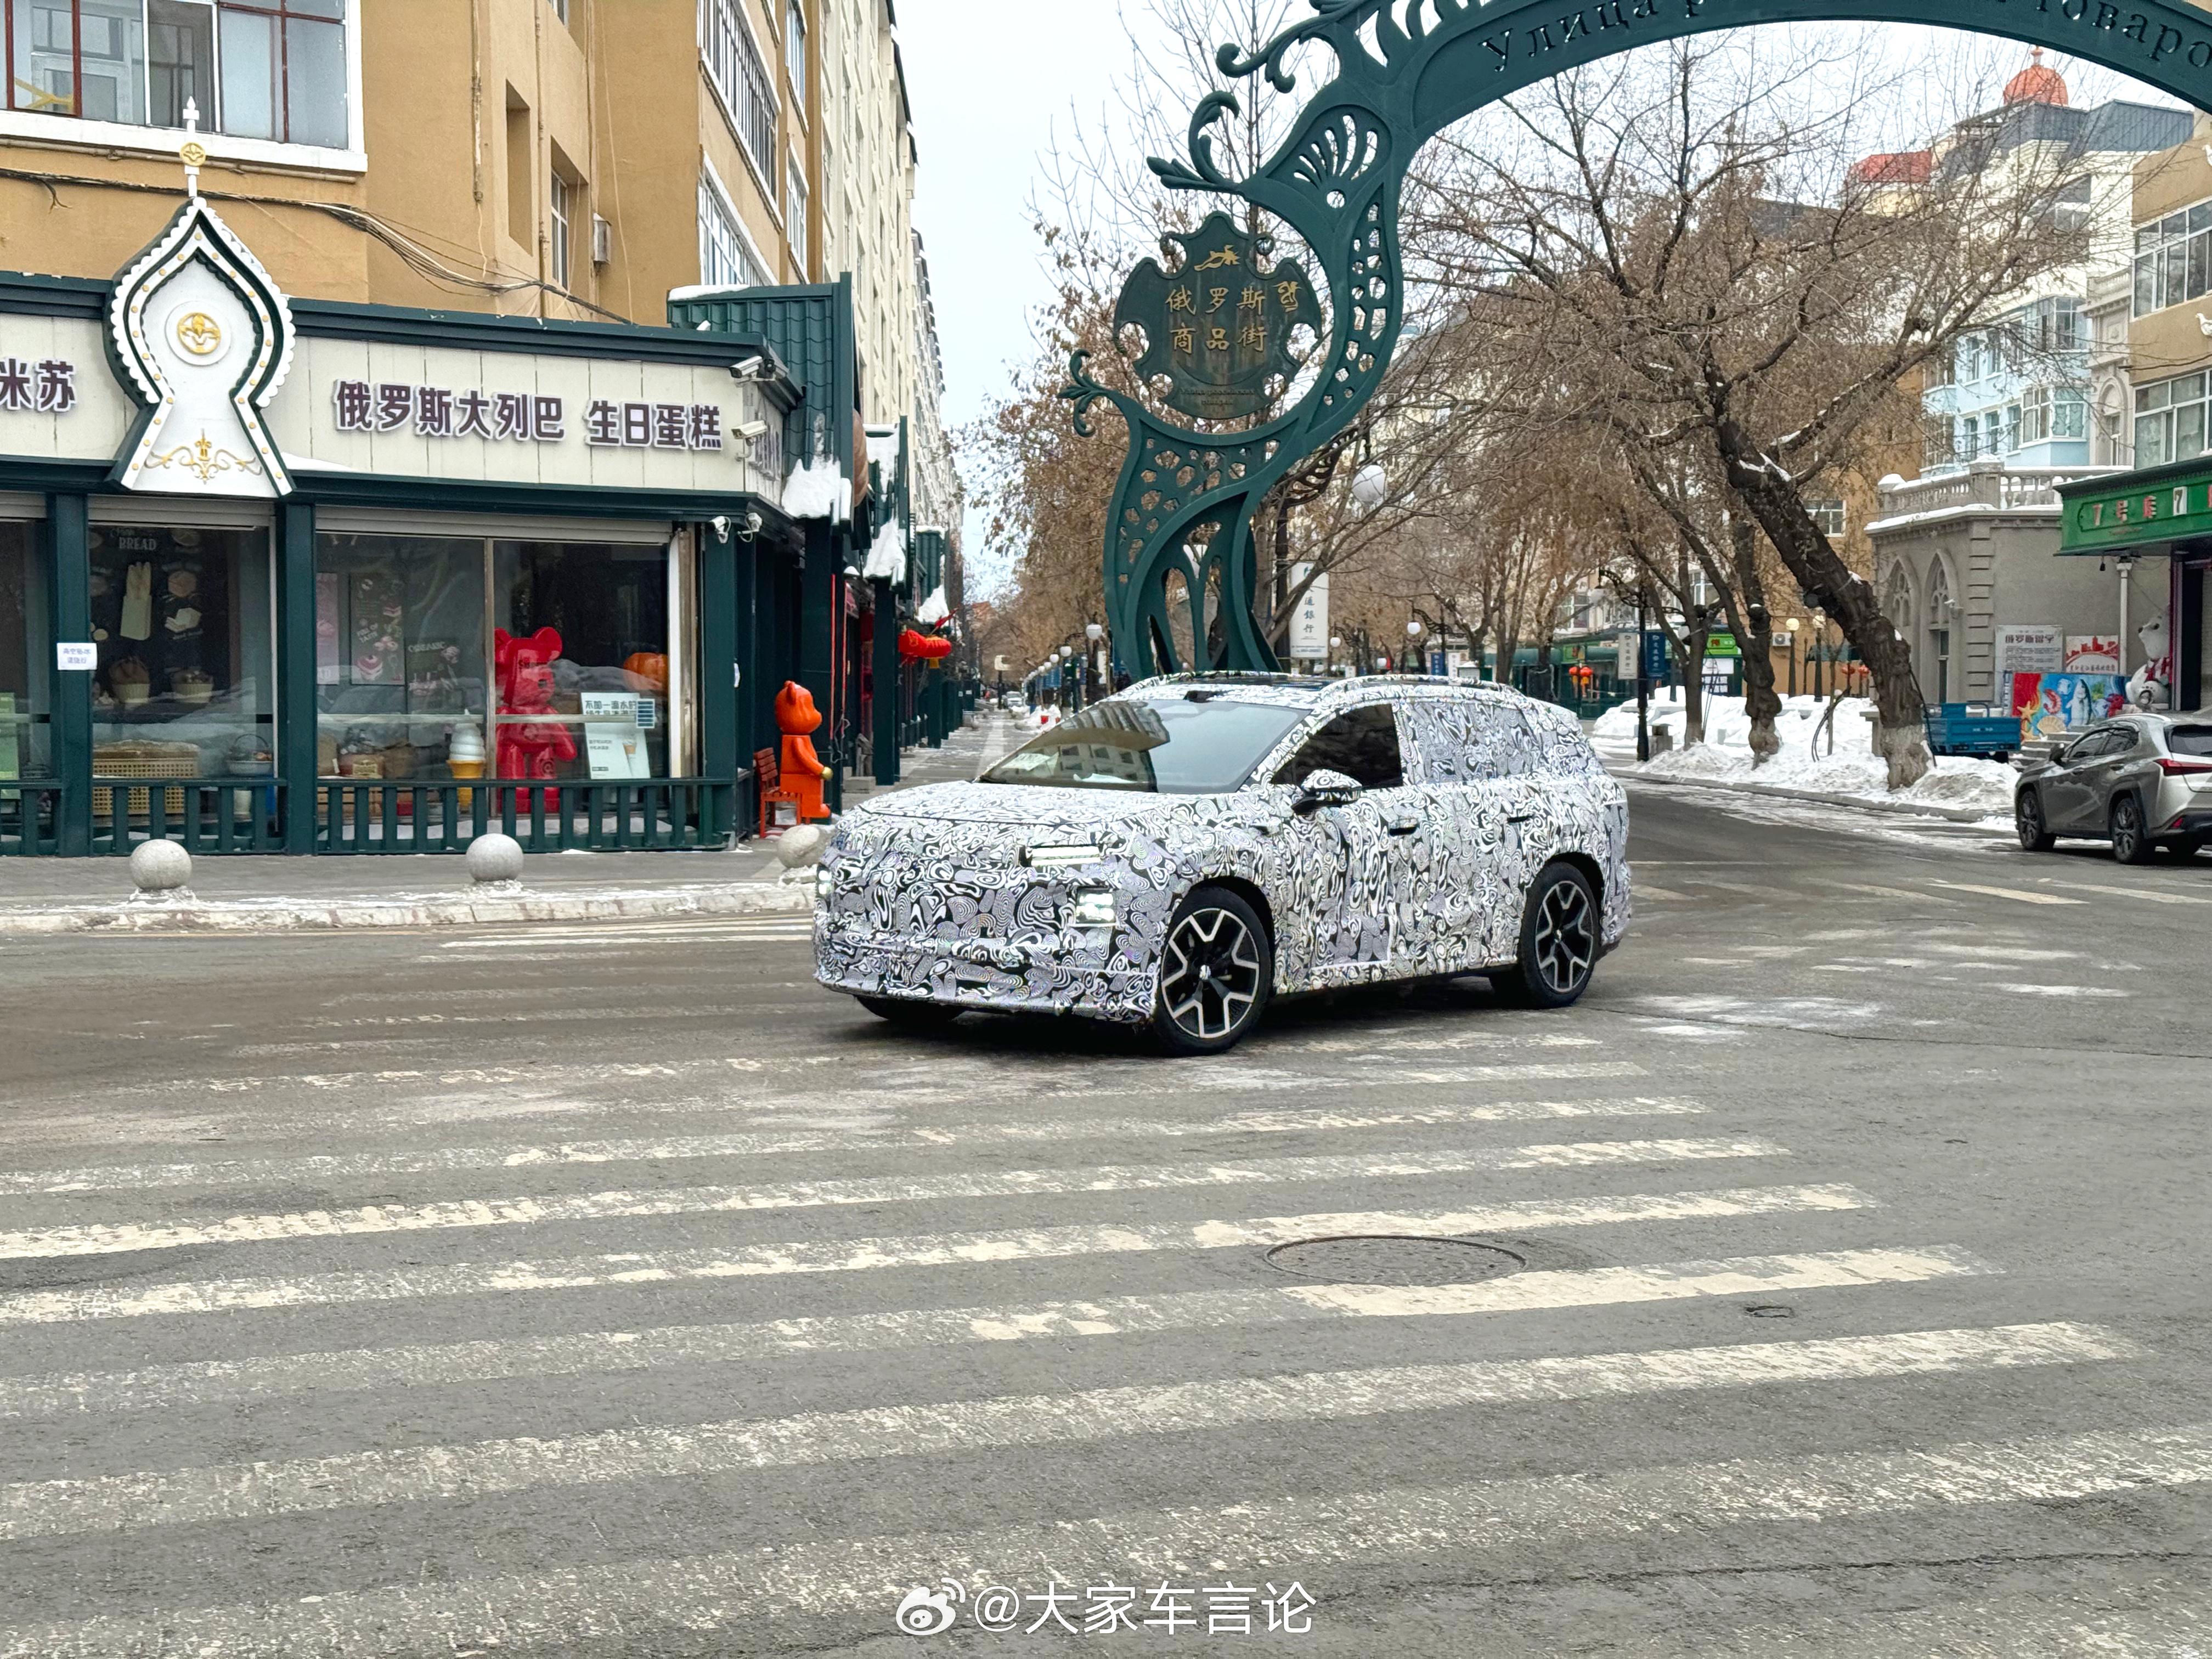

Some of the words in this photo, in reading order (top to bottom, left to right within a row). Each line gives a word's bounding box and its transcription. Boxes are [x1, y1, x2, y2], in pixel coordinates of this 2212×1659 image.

[1165, 284, 1266, 315] 俄罗斯
[1170, 322, 1268, 354] 商品街
[0, 358, 75, 410] 米苏
[336, 380, 563, 442] 俄罗斯大列巴
[588, 399, 723, 450] 生日蛋糕
[119, 536, 157, 551] BREAD
